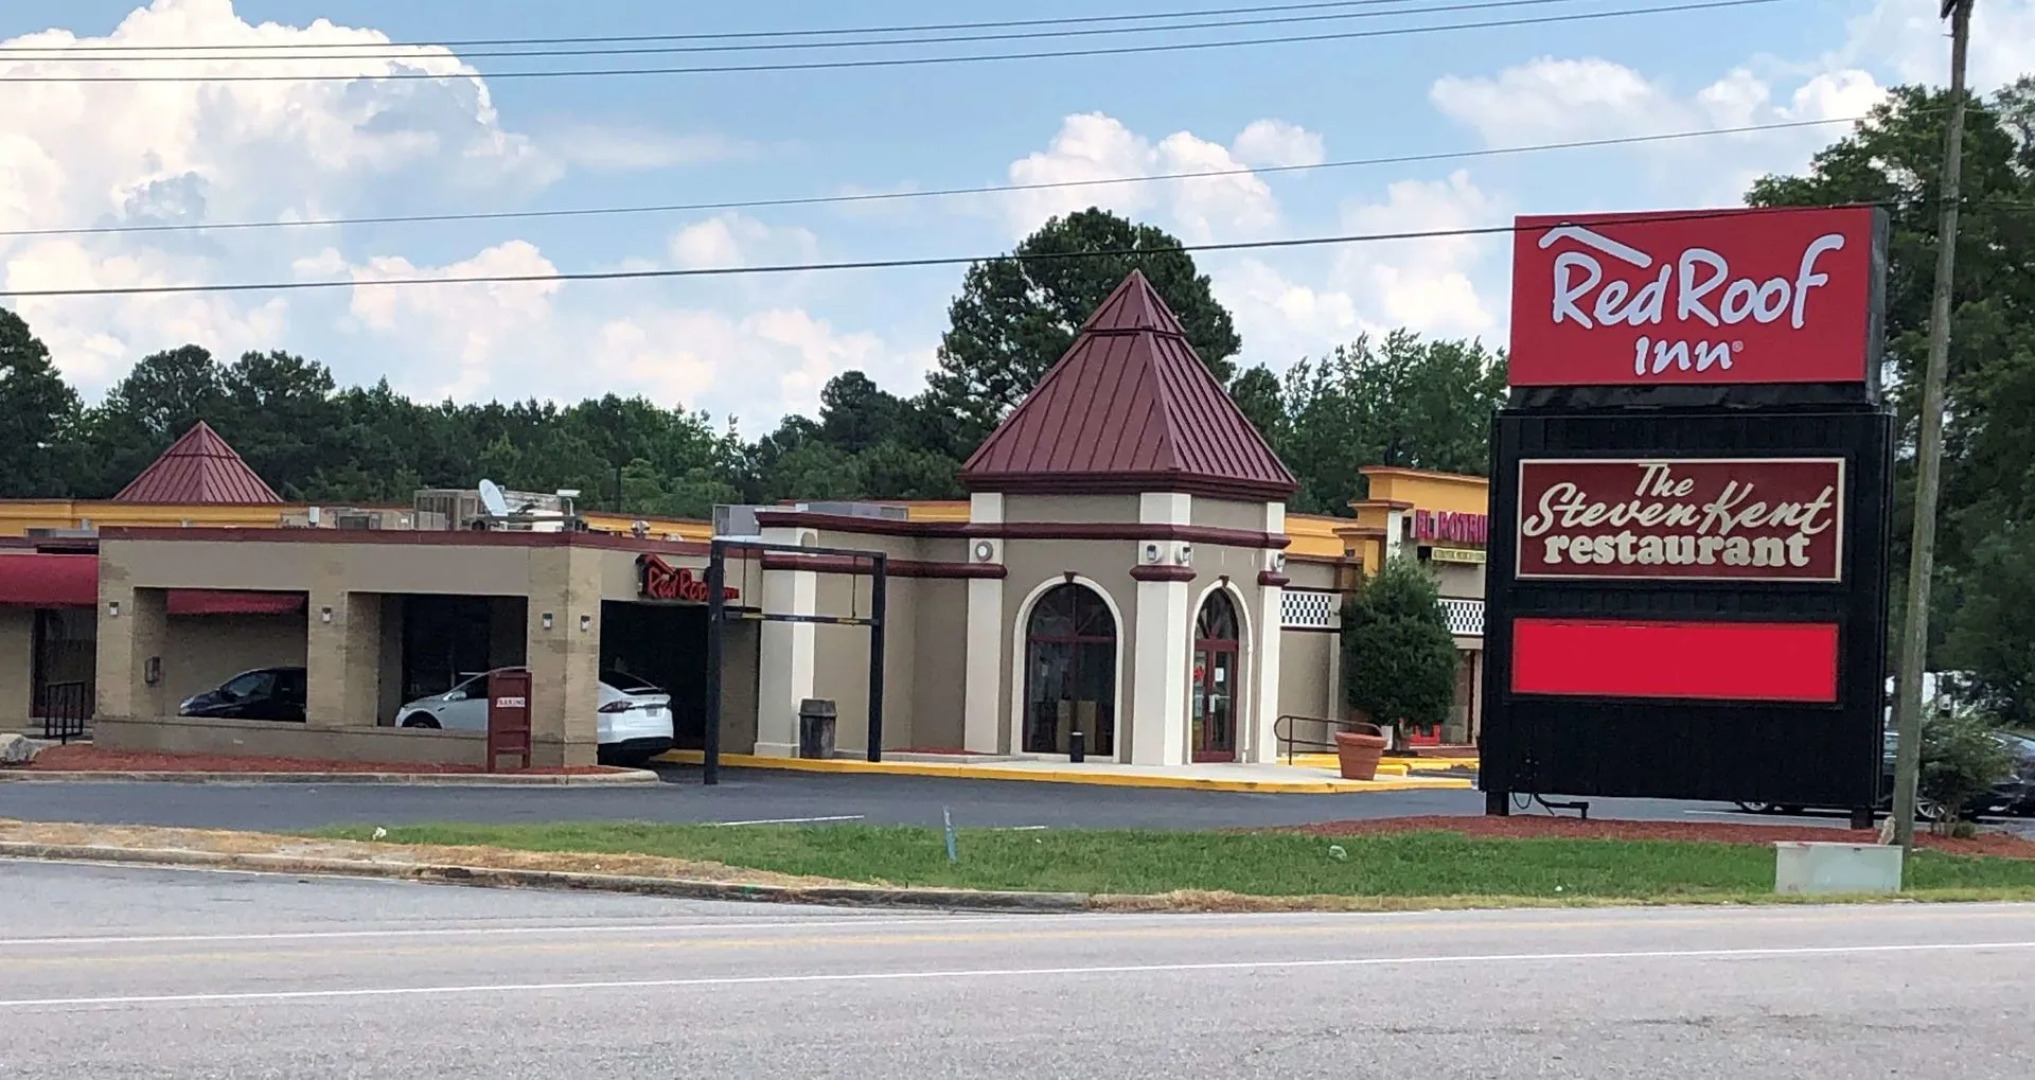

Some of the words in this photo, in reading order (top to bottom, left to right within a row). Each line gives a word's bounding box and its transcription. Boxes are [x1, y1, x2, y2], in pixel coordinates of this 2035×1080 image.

[1552, 251, 1672, 329] Red
[1678, 234, 1845, 329] Roof
[1637, 463, 1695, 497] The
[1413, 509, 1435, 539] EL
[1523, 482, 1700, 536] Steven
[1697, 480, 1834, 535] Kent
[1543, 530, 1811, 567] restaurant
[646, 566, 677, 600] Red
[677, 567, 713, 602] Roo
